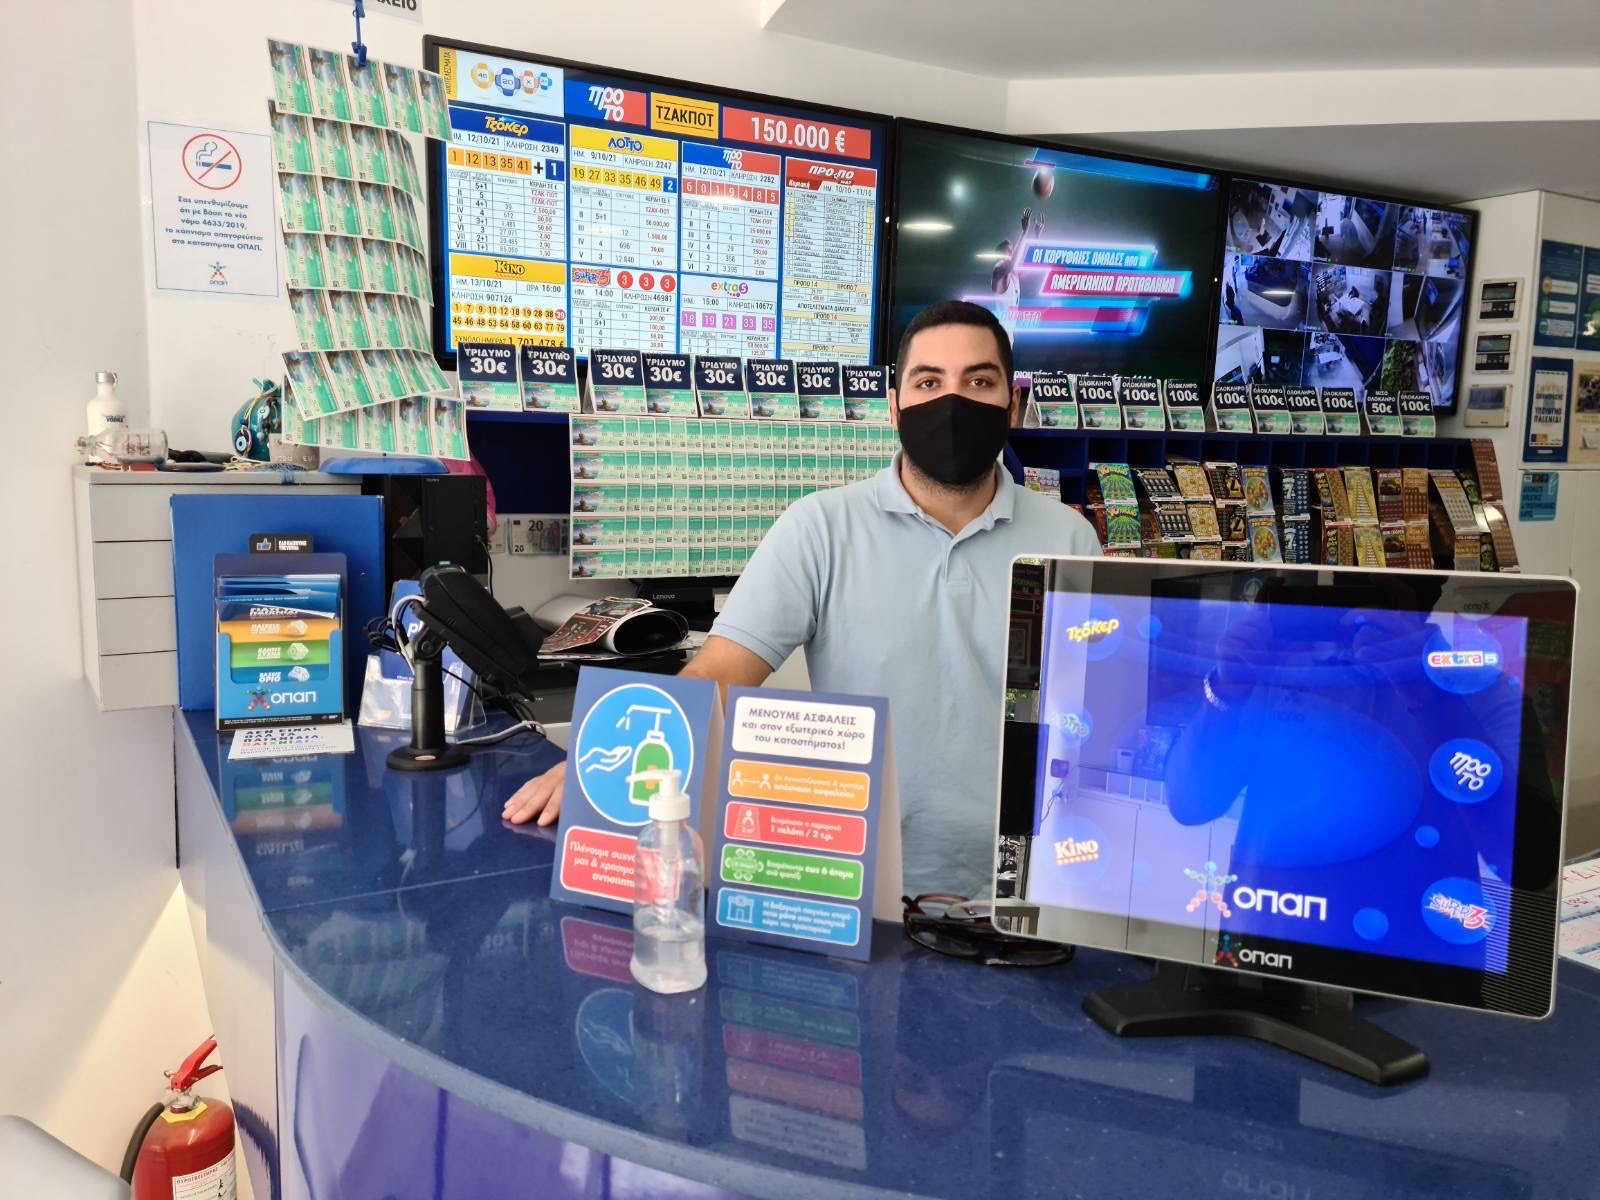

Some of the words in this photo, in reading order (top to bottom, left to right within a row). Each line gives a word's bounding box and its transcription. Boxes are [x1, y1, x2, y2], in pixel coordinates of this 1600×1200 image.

[656, 106, 714, 128] ΤΖΑΚΠΟΤ
[467, 134, 500, 146] 12/10/21
[752, 117, 830, 150] 150.000
[834, 130, 846, 152] €
[506, 140, 538, 152] ΚΛΗΡΩΣΗ
[541, 144, 559, 154] 2349
[590, 152, 617, 162] 9/10/21
[466, 154, 479, 165] 12
[483, 156, 496, 168] 13
[500, 157, 514, 169] 35
[517, 159, 530, 171] 41
[550, 163, 558, 176] 1
[656, 160, 672, 170] 2247
[573, 167, 585, 178] 19
[588, 168, 600, 180] 27
[604, 170, 616, 182] 33
[620, 173, 632, 184] 35
[635, 175, 647, 187] 46
[650, 178, 661, 189] 49
[667, 178, 674, 190] 2
[699, 167, 726, 178] 12/10/21
[686, 182, 692, 192] 6
[701, 183, 707, 194] 0
[730, 187, 736, 197] 9
[742, 189, 748, 199] 4
[756, 190, 762, 200] 8
[770, 192, 776, 202] 5
[1044, 249, 1091, 265] ΚΟΡΥΦΑΙΕΣ
[1092, 252, 1125, 266] ΟΜΑΔΕΣ
[470, 278, 502, 288] 13/10/21
[622, 275, 628, 284] 3
[644, 278, 649, 287] 3
[664, 280, 670, 288] 3
[1050, 274, 1114, 292] ΑΜΕΡΙΚΑΝΙΚΟ
[1115, 276, 1176, 292] ΠΡΩΤΑΘΛΗΜΑ
[542, 284, 562, 293] 16:00
[595, 289, 614, 298] 14:00
[452, 292, 484, 301] ΚΛΗΡΩΣΗ
[486, 294, 513, 302] 907126
[654, 294, 672, 302] 46981
[488, 306, 497, 314] 10
[500, 306, 508, 315] 12
[512, 308, 520, 316] 18
[523, 308, 532, 317] 19
[534, 309, 542, 318] 28
[545, 310, 554, 318] 38
[556, 310, 565, 319] 39
[756, 302, 774, 311] 10672
[452, 317, 462, 325] 45
[464, 318, 474, 326] 46
[476, 318, 486, 326] 48
[488, 318, 497, 327] 53
[500, 320, 508, 328] 54
[511, 320, 520, 329] 58
[522, 322, 532, 330] 60
[534, 322, 542, 330] 63
[545, 323, 554, 332] 77
[556, 324, 564, 332] 79
[684, 314, 694, 324] 18
[704, 315, 714, 325] 19
[724, 316, 734, 326] 21
[744, 318, 754, 328] 33
[763, 318, 773, 329] 35
[466, 348, 510, 358] ΤΡΙΔΥΜΟ
[528, 350, 570, 360] ΤΡΙΔΥΜΟ
[598, 354, 638, 364] ΤΡΙΔΥΜΟ
[470, 358, 508, 374] 30€
[532, 360, 567, 376] 30€
[647, 358, 686, 368] ΤΡΙΔΥΜΟ
[701, 361, 738, 370] ΤΡΙΔΥΜΟ
[752, 364, 788, 372] ΤΡΙΔΥΜΟ
[602, 363, 635, 379] 30€
[650, 367, 682, 382] 30€
[798, 366, 834, 374] ΤΡΙΔΥΜΟ
[846, 370, 882, 378] ΤΡΙΔΥΜΟ
[704, 370, 735, 384] 30€
[756, 372, 786, 386] 30€
[802, 374, 832, 388] 30€
[850, 378, 878, 391] 30€
[1035, 385, 1068, 397] 100€
[1080, 388, 1112, 400] 100€
[1123, 389, 1156, 401] 100€
[1170, 390, 1199, 402] 100€
[1216, 393, 1246, 404] 100€
[1254, 395, 1284, 406] 100€
[1288, 396, 1318, 407] 100€
[1324, 398, 1354, 408] 100€
[1372, 402, 1392, 414] 50€
[1401, 401, 1430, 412] 100€
[528, 520, 544, 532] 20
[749, 708, 801, 721] ΜΕΝΟΥΜΕ
[804, 712, 856, 726] ΑΣΦΑΛΕΙΣ
[742, 721, 757, 730] και
[760, 723, 782, 732] στον
[786, 724, 834, 737] εξωτερικό
[837, 728, 865, 741] χώρο
[755, 735, 772, 743] του
[774, 736, 846, 750] καταστήματος!
[812, 830, 818, 838] 2
[570, 842, 609, 858] Πλένουμε
[574, 857, 588, 866] μας
[590, 858, 598, 867] &
